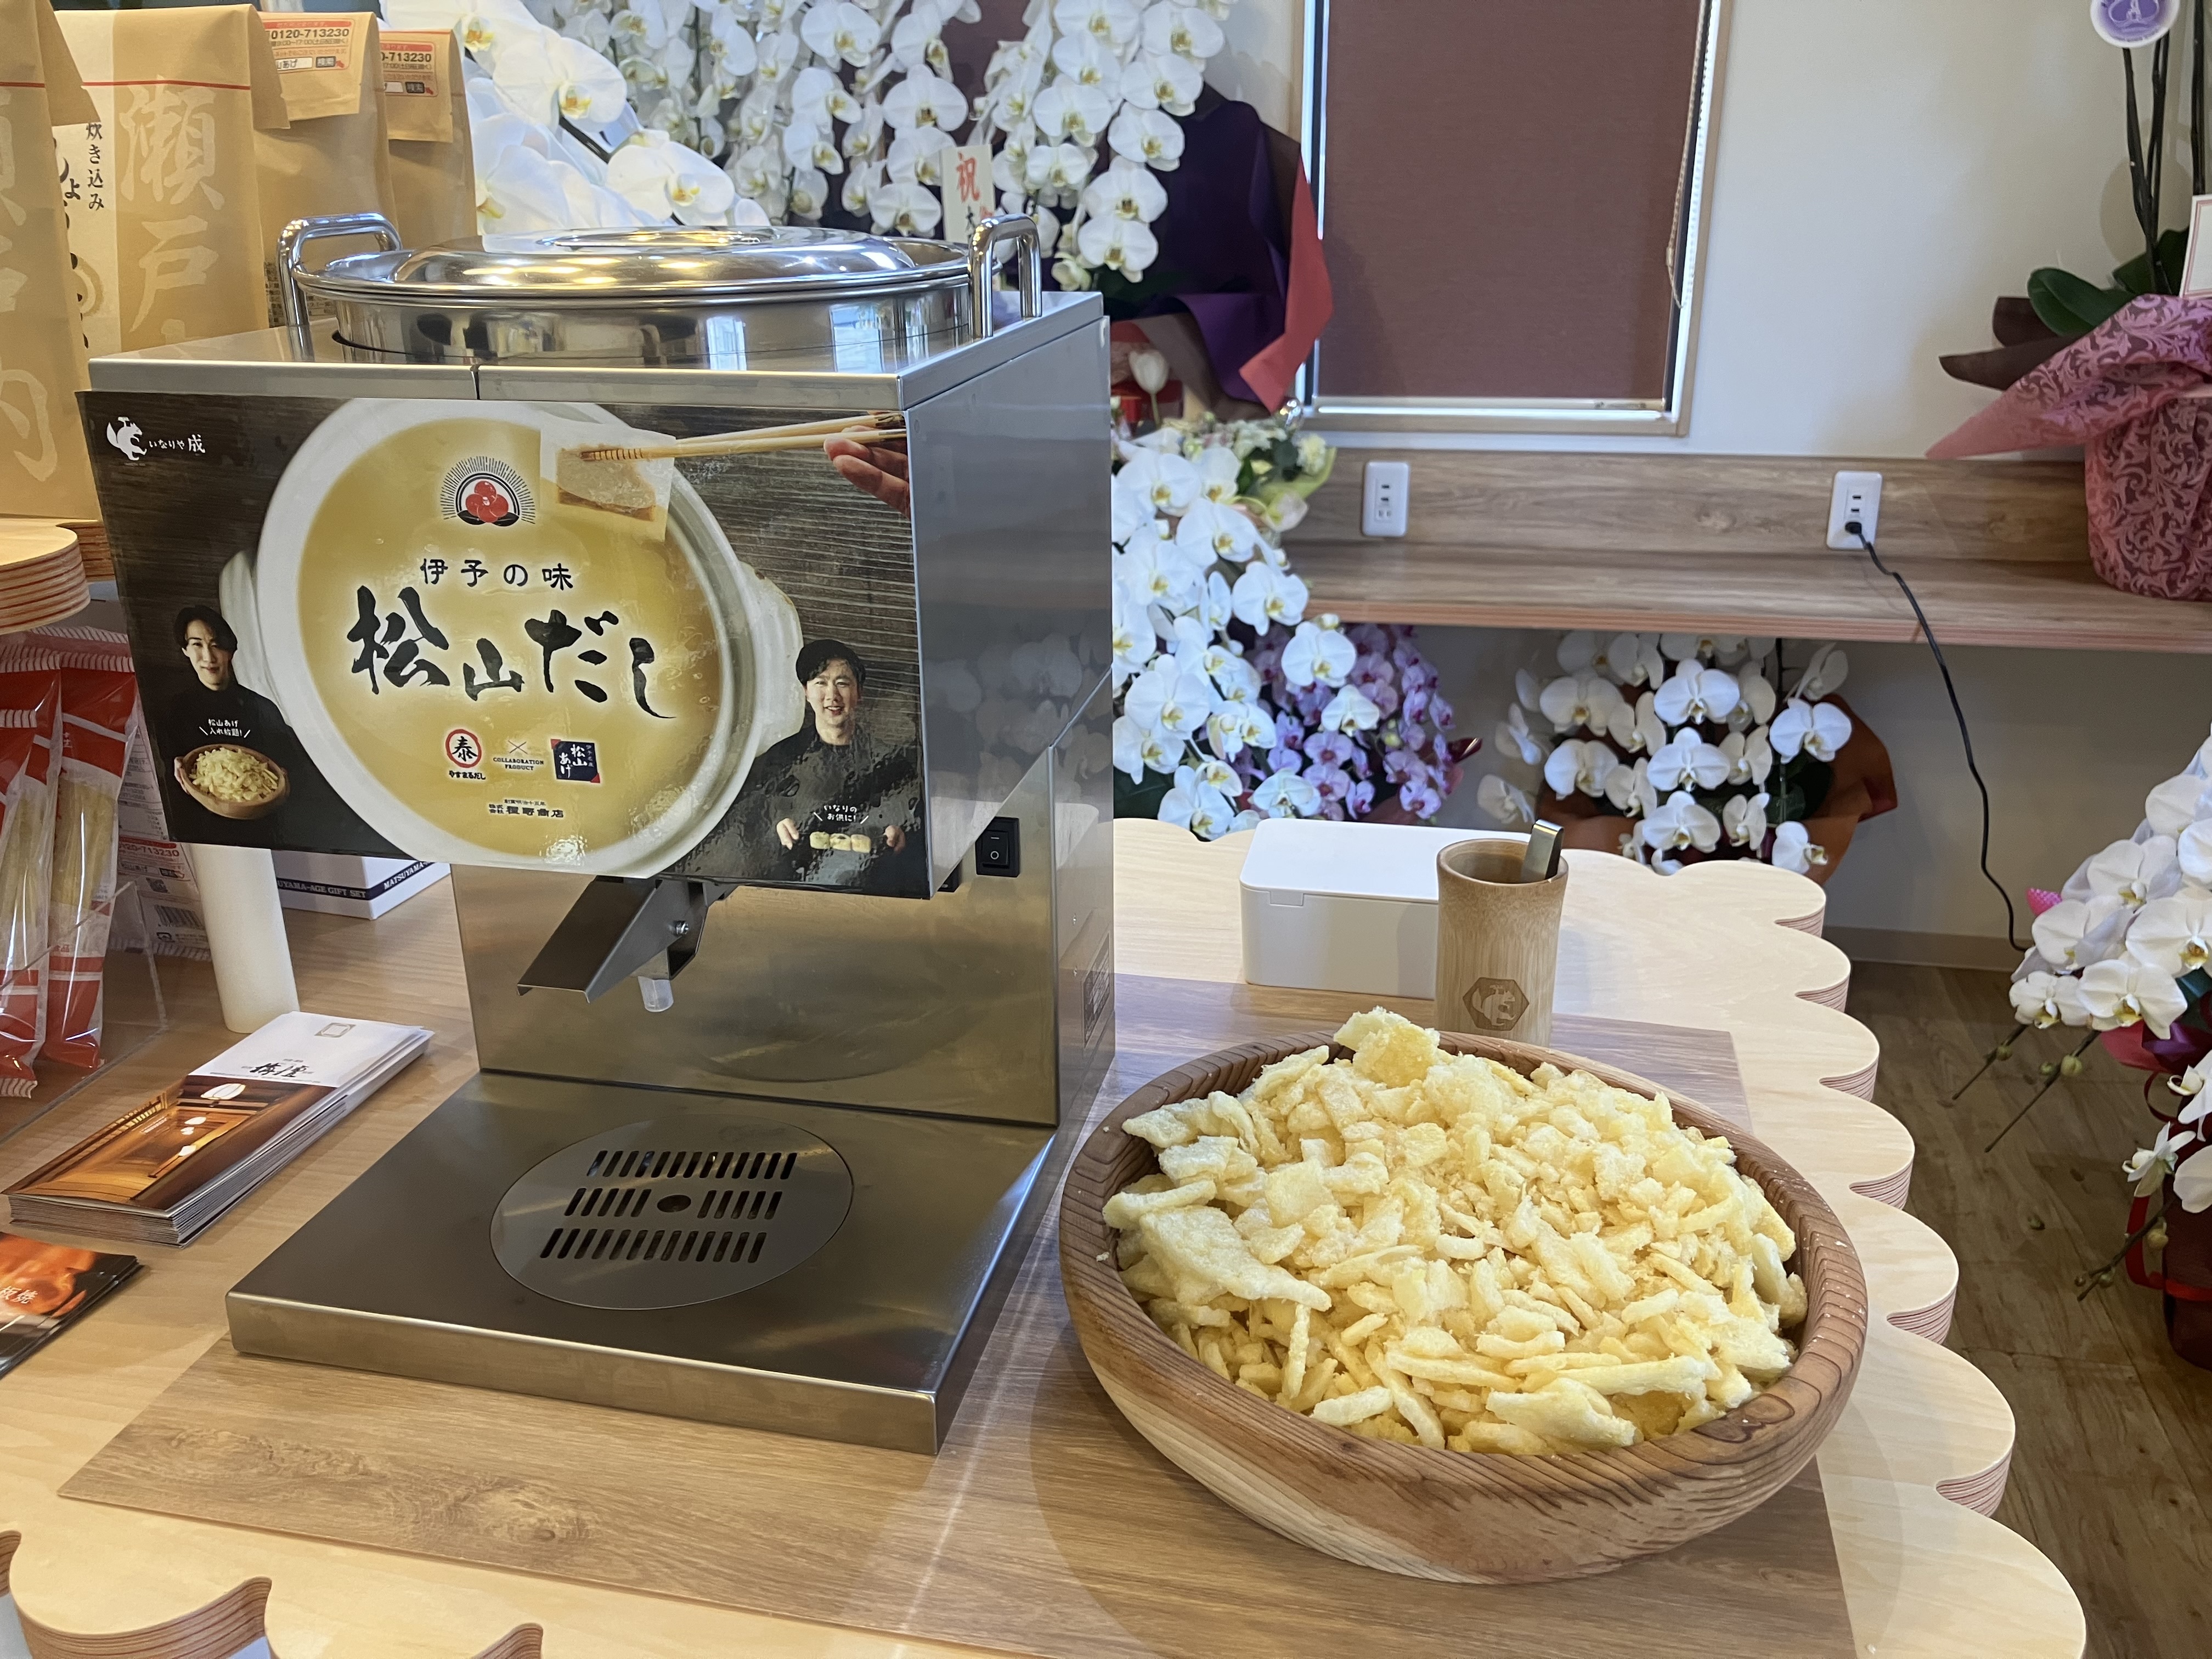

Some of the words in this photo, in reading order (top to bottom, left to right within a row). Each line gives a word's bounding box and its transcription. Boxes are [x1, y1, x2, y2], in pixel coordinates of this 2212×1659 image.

[271, 28, 349, 39] 0120-713230
[85, 122, 104, 211] 炊き込み
[120, 75, 225, 341] 瀬戸
[420, 558, 573, 591] 伊予の味
[347, 585, 677, 719] 松山だし
[208, 719, 239, 727] 松山あげ
[452, 736, 478, 762] 泰
[493, 757, 544, 765] COLLABORATION
[449, 770, 487, 780] やすまるだし
[823, 804, 857, 813] いなりの
[329, 887, 347, 895] GIFT
[349, 889, 366, 898] SET
